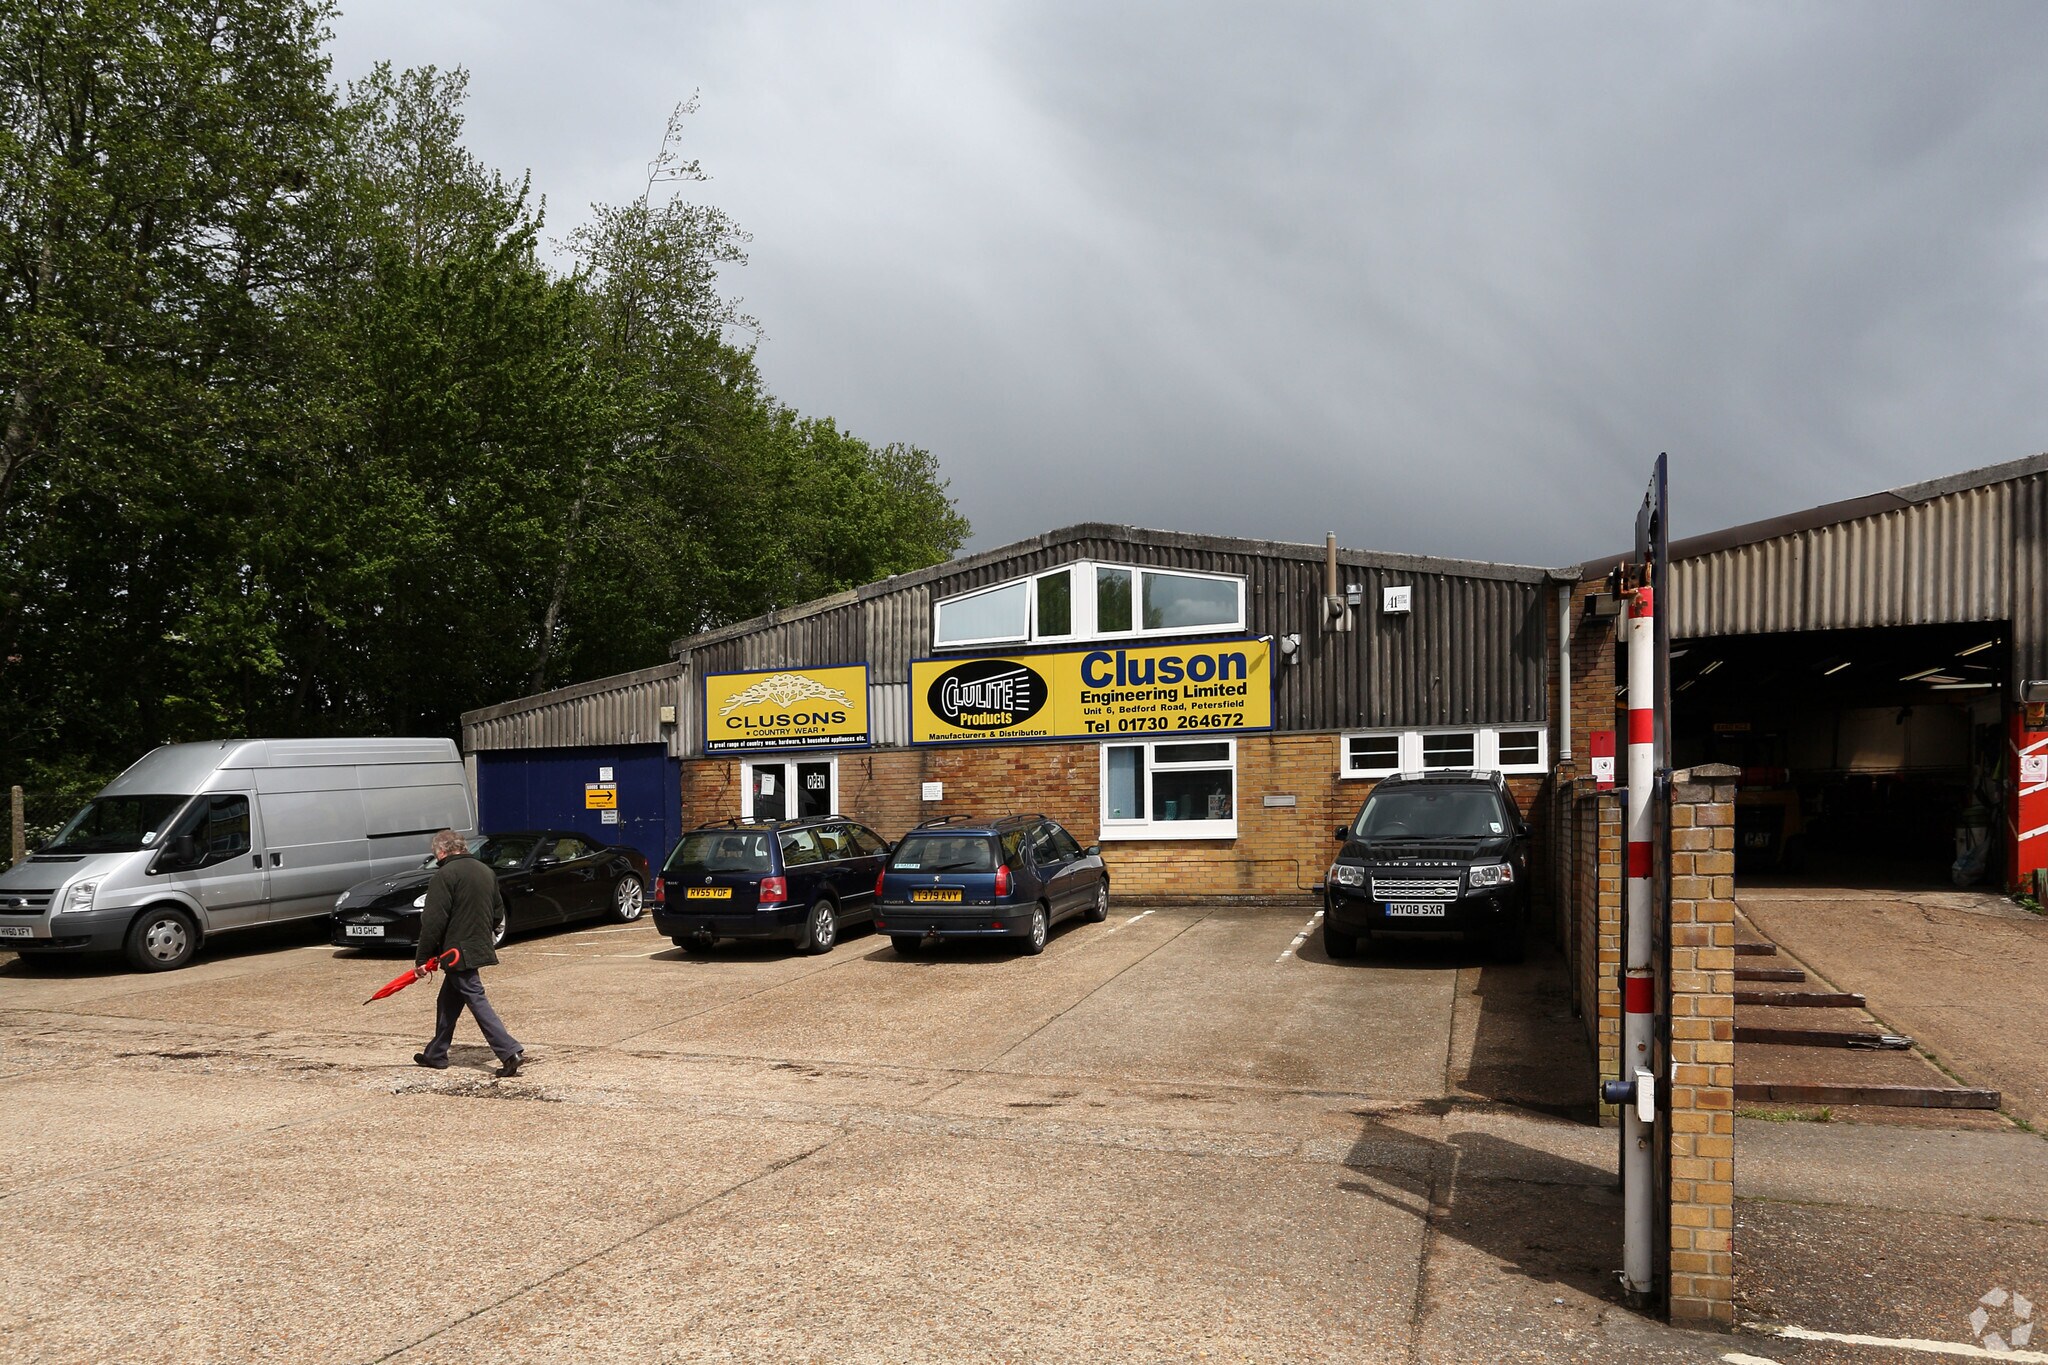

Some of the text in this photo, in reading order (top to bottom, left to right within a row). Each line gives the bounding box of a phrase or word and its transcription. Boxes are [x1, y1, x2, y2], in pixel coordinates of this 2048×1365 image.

[1081, 650, 1247, 688] Cluson
[942, 677, 1013, 717] CLULITE
[1081, 682, 1247, 706] Engineering Limited
[1084, 700, 1244, 715] Unit 6, Bedford Road, Petersfield
[726, 711, 846, 729] CLUSONS
[960, 712, 1013, 726] Products
[1085, 713, 1244, 733] Tel 01730 264672
[753, 728, 791, 736] COUNTRY
[929, 732, 986, 740] Manufacturers
[1000, 729, 1047, 737] Distributors
[746, 740, 763, 748] country
[808, 776, 824, 788] OPEN
[1745, 832, 1770, 847] CAT
[691, 888, 728, 897] RV55 YOF
[917, 890, 959, 900] T379 AVY
[1392, 905, 1442, 914] HY08 SXR
[363, 926, 377, 935] GHC
